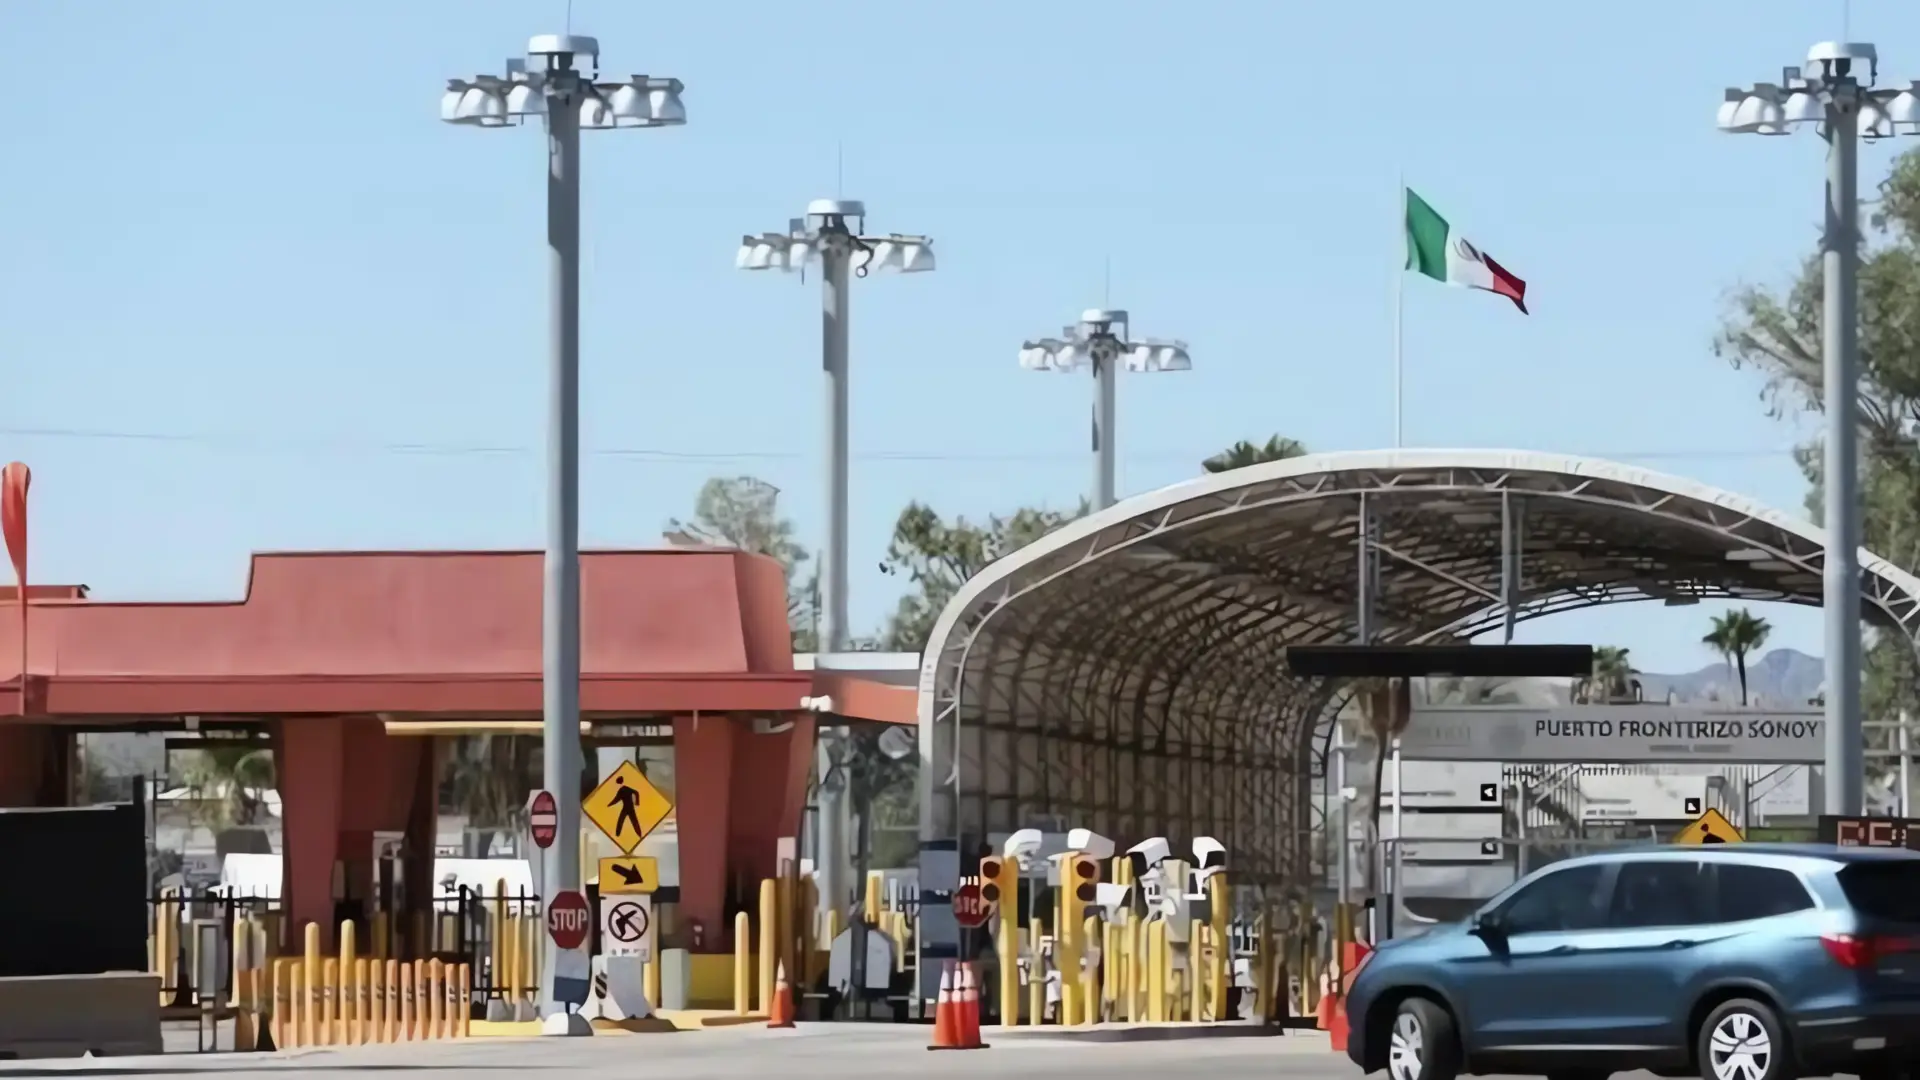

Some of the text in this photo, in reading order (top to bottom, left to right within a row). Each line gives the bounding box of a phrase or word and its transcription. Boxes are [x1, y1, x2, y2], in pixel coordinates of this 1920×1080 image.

[1535, 720, 1613, 737] PUERTO
[1748, 720, 1824, 738] SONOY
[549, 908, 588, 931] STOP
